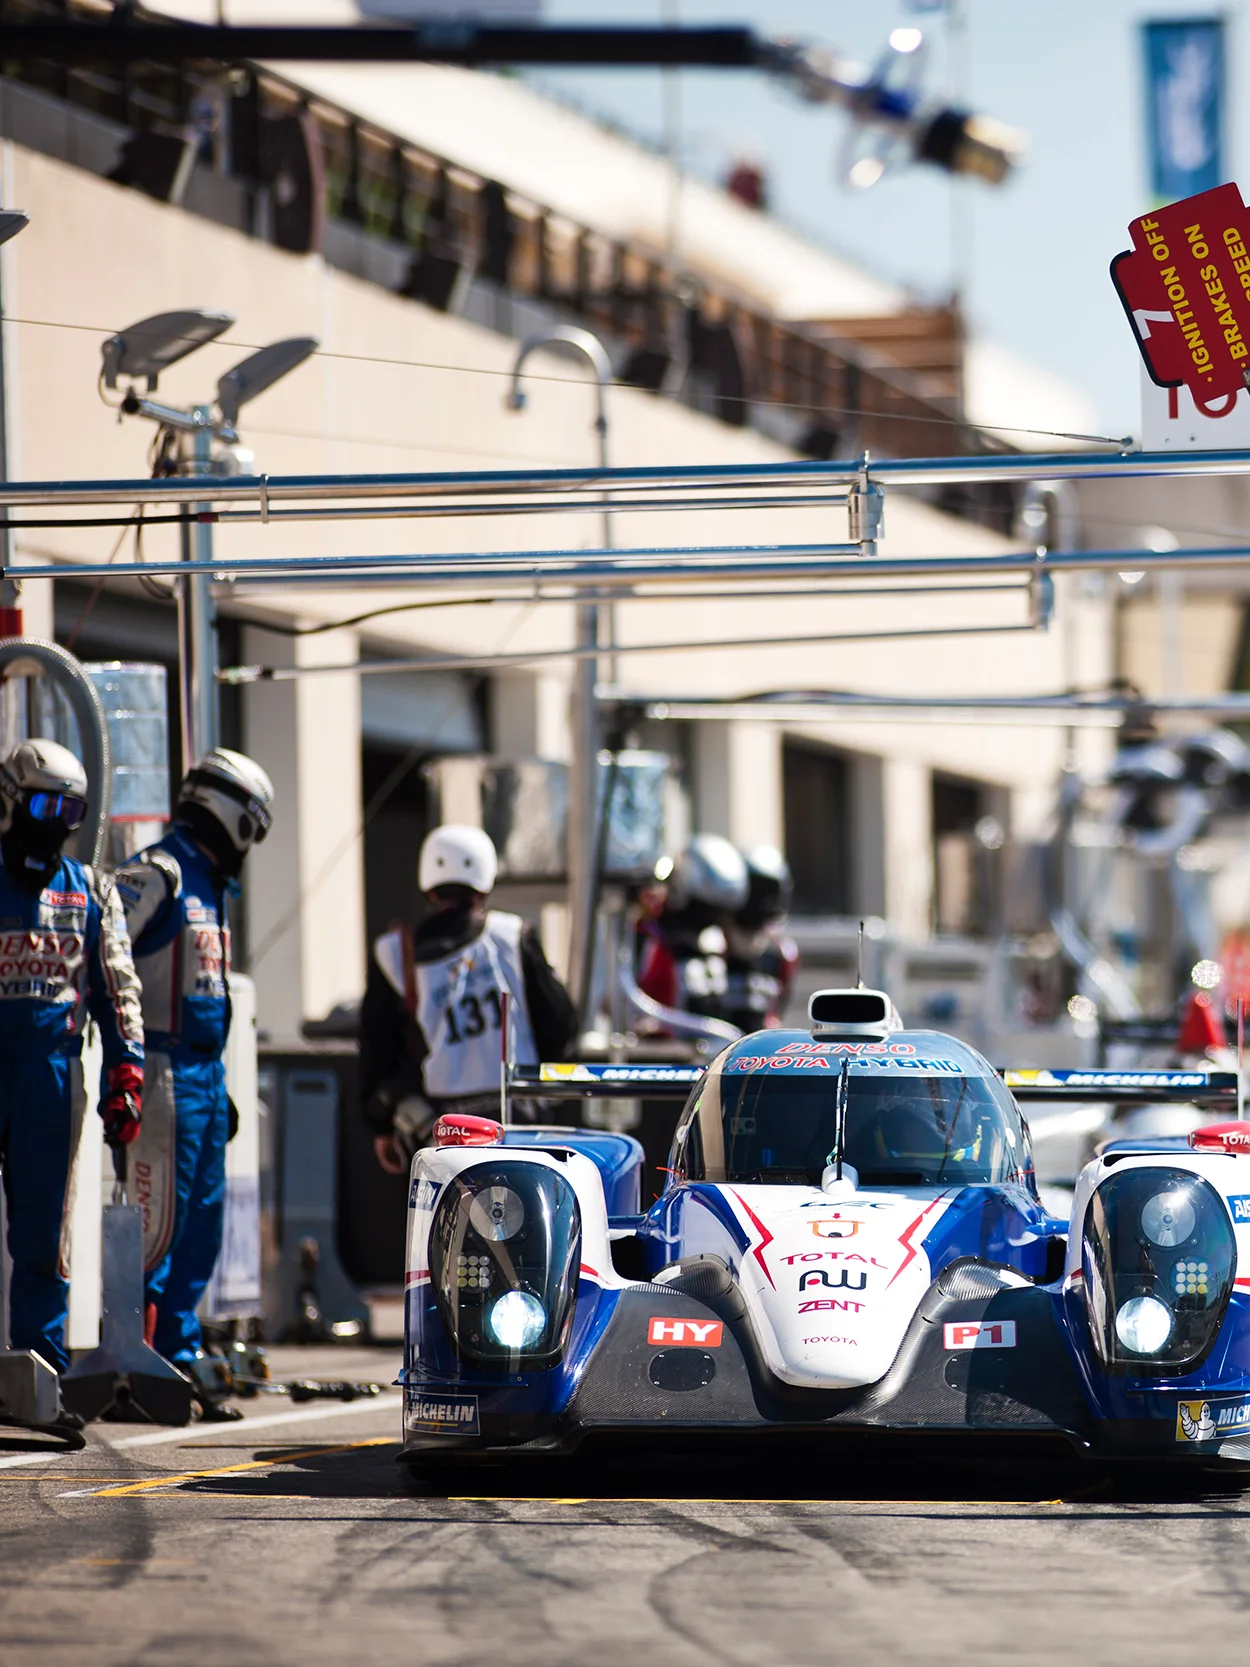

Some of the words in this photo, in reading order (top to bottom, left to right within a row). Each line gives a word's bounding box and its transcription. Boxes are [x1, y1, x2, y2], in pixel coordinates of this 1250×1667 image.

[1140, 218, 1170, 261] OFF
[1184, 223, 1209, 259] ON
[1160, 266, 1214, 374] IGNITION
[1200, 264, 1249, 360] BRAKES
[1132, 308, 1174, 341] 7
[0, 934, 81, 958] ENSO
[445, 986, 502, 1044] 131
[775, 1042, 916, 1055] DENSO
[729, 1056, 830, 1072] TOYOTA
[838, 1056, 965, 1074] HYBRID
[1065, 1073, 1204, 1086] MICHELIN
[437, 1125, 471, 1136] TOTAL
[780, 1252, 888, 1270] TOTAL
[798, 1299, 866, 1314] ZENT
[652, 1321, 719, 1342] HY
[802, 1336, 858, 1346] TOYOTA
[953, 1325, 1003, 1344] P1
[409, 1402, 475, 1422] MICHELIN
